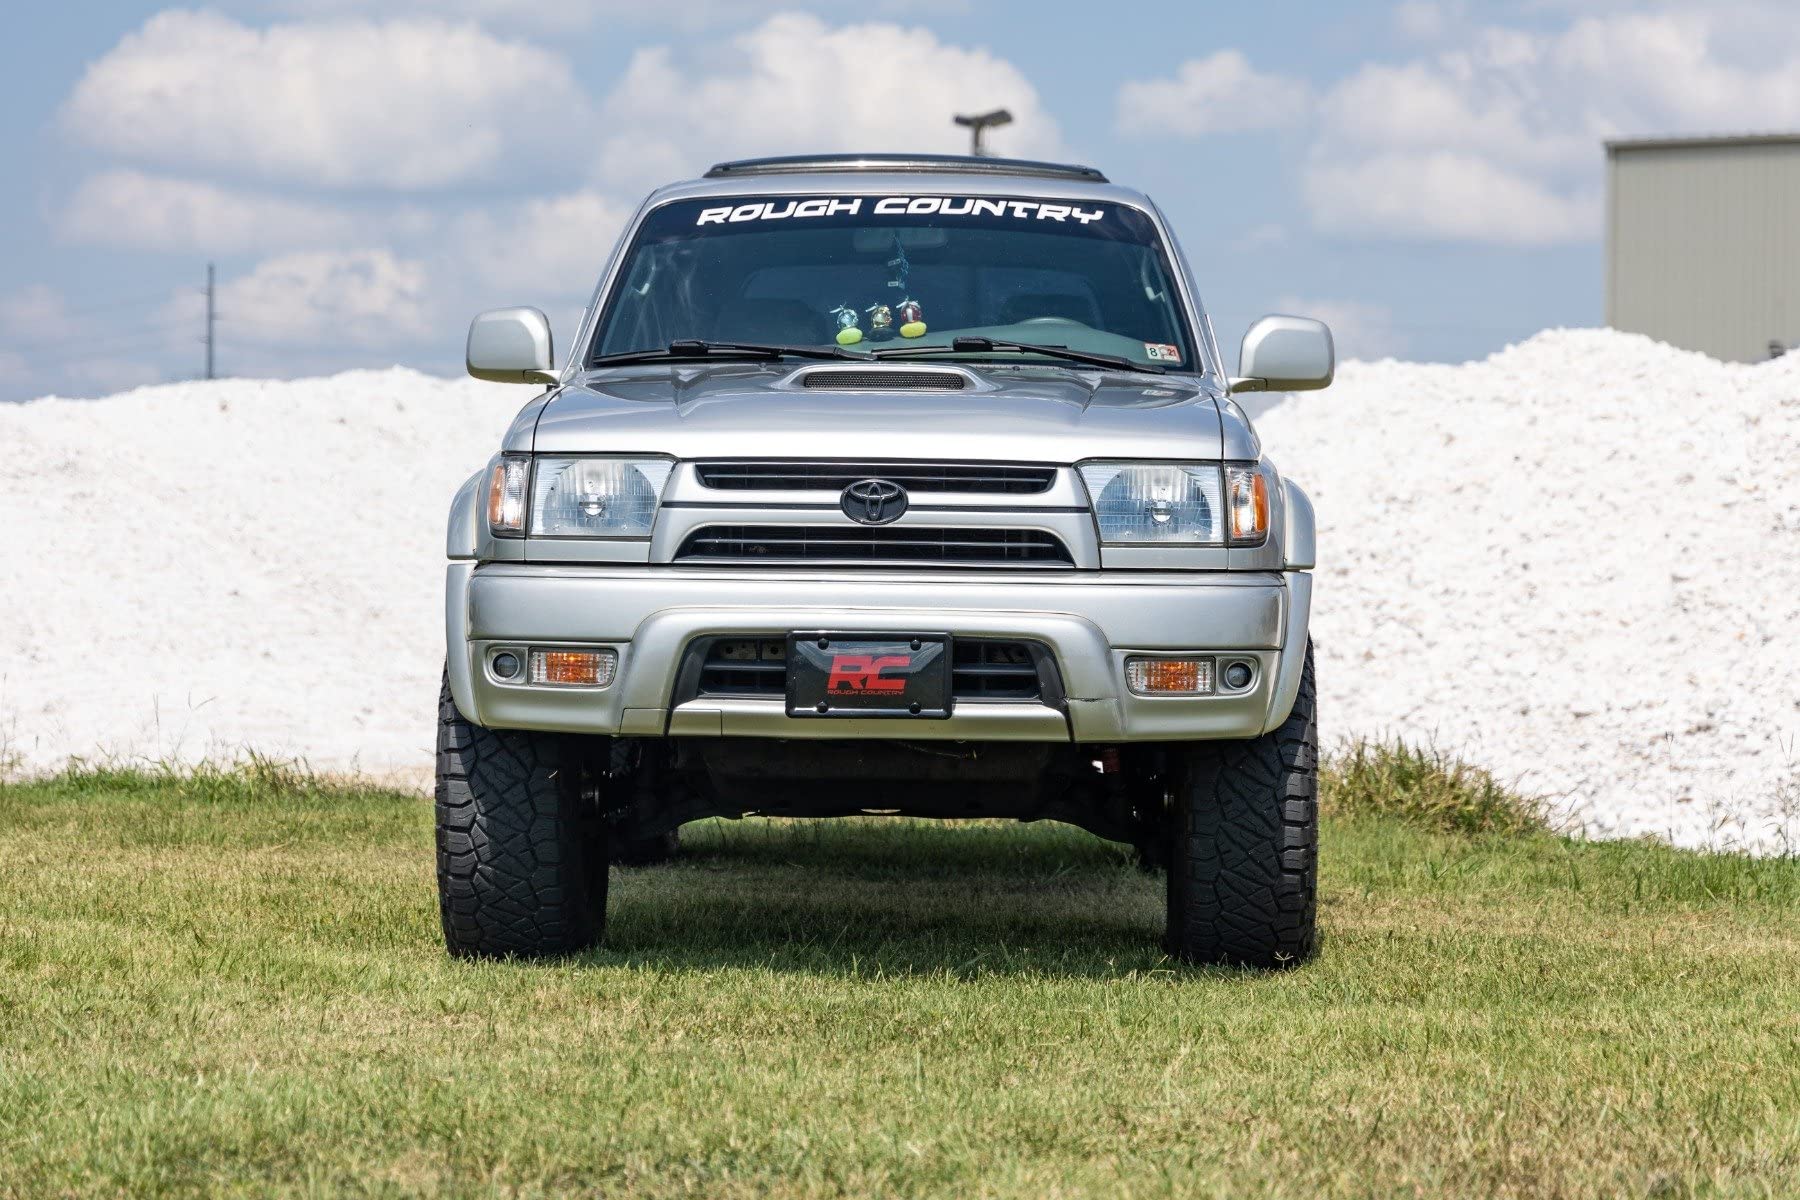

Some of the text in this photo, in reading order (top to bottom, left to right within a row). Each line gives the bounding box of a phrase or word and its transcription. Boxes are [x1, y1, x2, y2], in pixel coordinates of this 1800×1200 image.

[696, 197, 1104, 226] ROUGH COUNTRY
[1149, 347, 1158, 357] 8
[827, 655, 911, 690] RC
